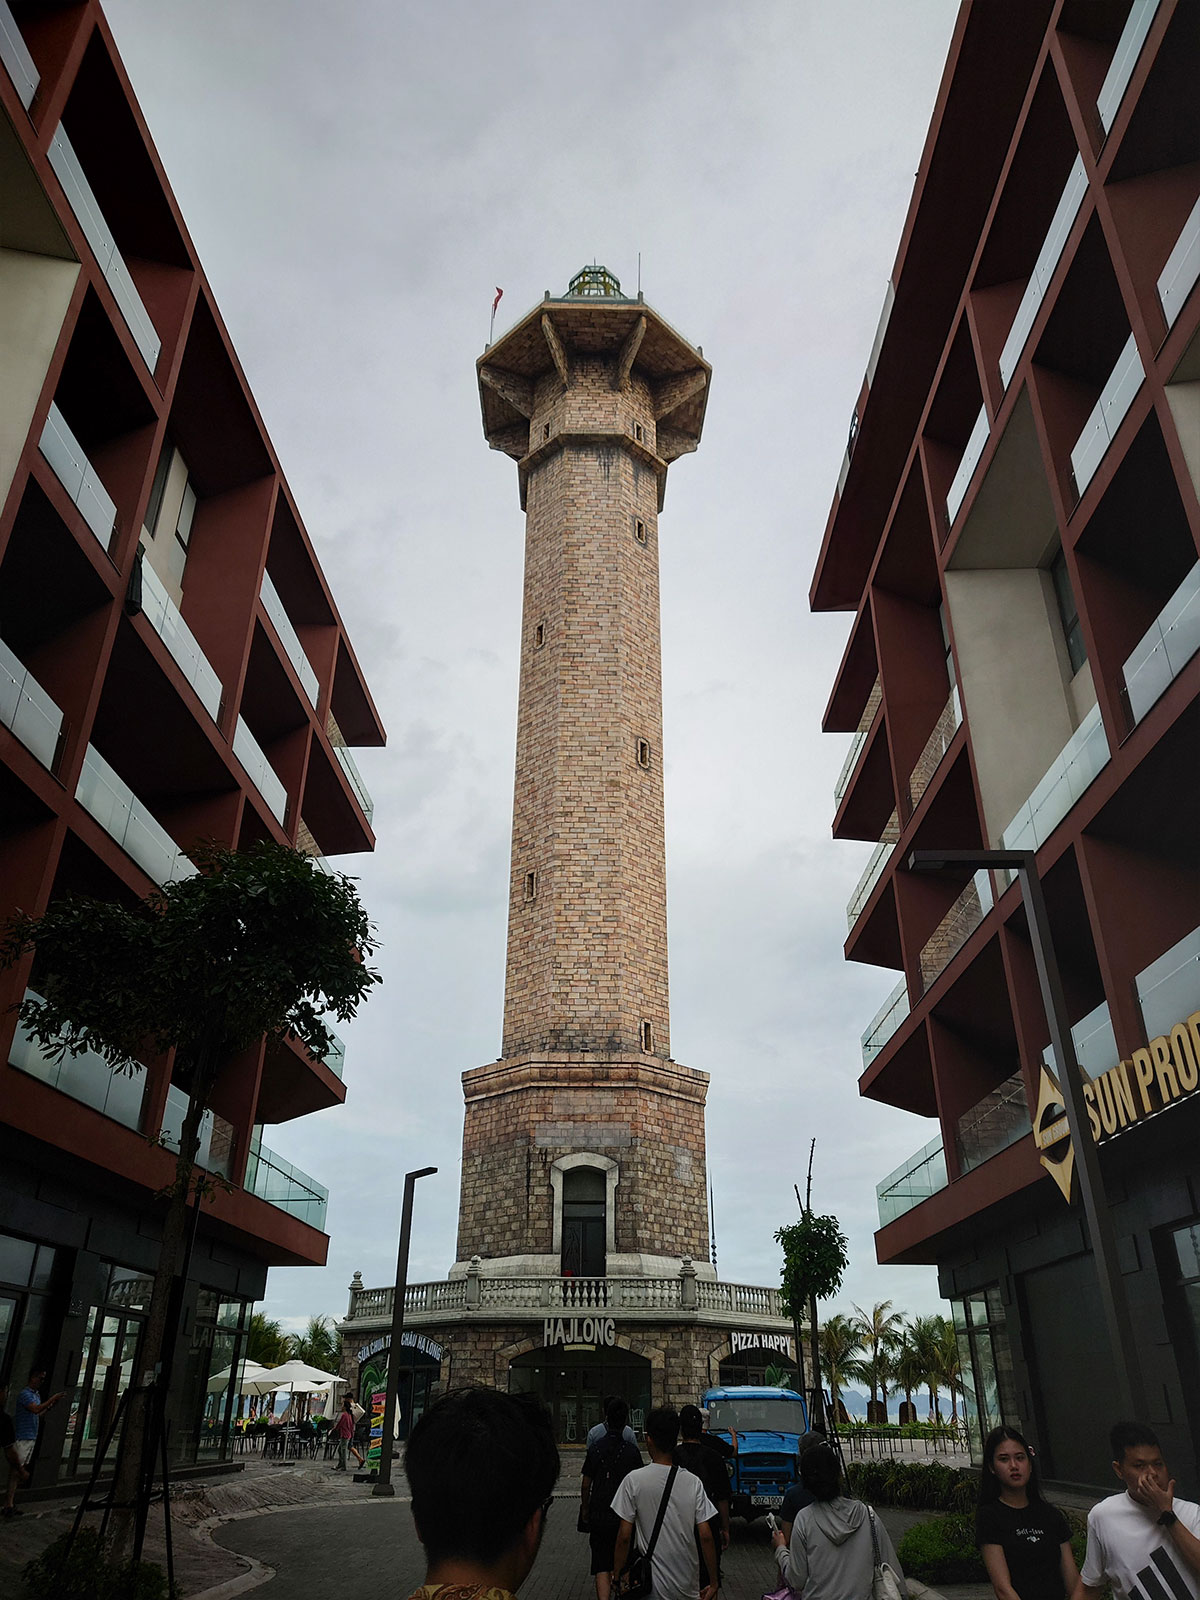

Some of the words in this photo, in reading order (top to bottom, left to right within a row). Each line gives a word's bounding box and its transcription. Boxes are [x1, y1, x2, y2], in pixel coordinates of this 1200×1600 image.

[1082, 1060, 1138, 1143] SUN
[425, 1340, 442, 1361] LONG
[731, 1332, 760, 1354] PIZZA
[761, 1334, 791, 1357] HAPPY
